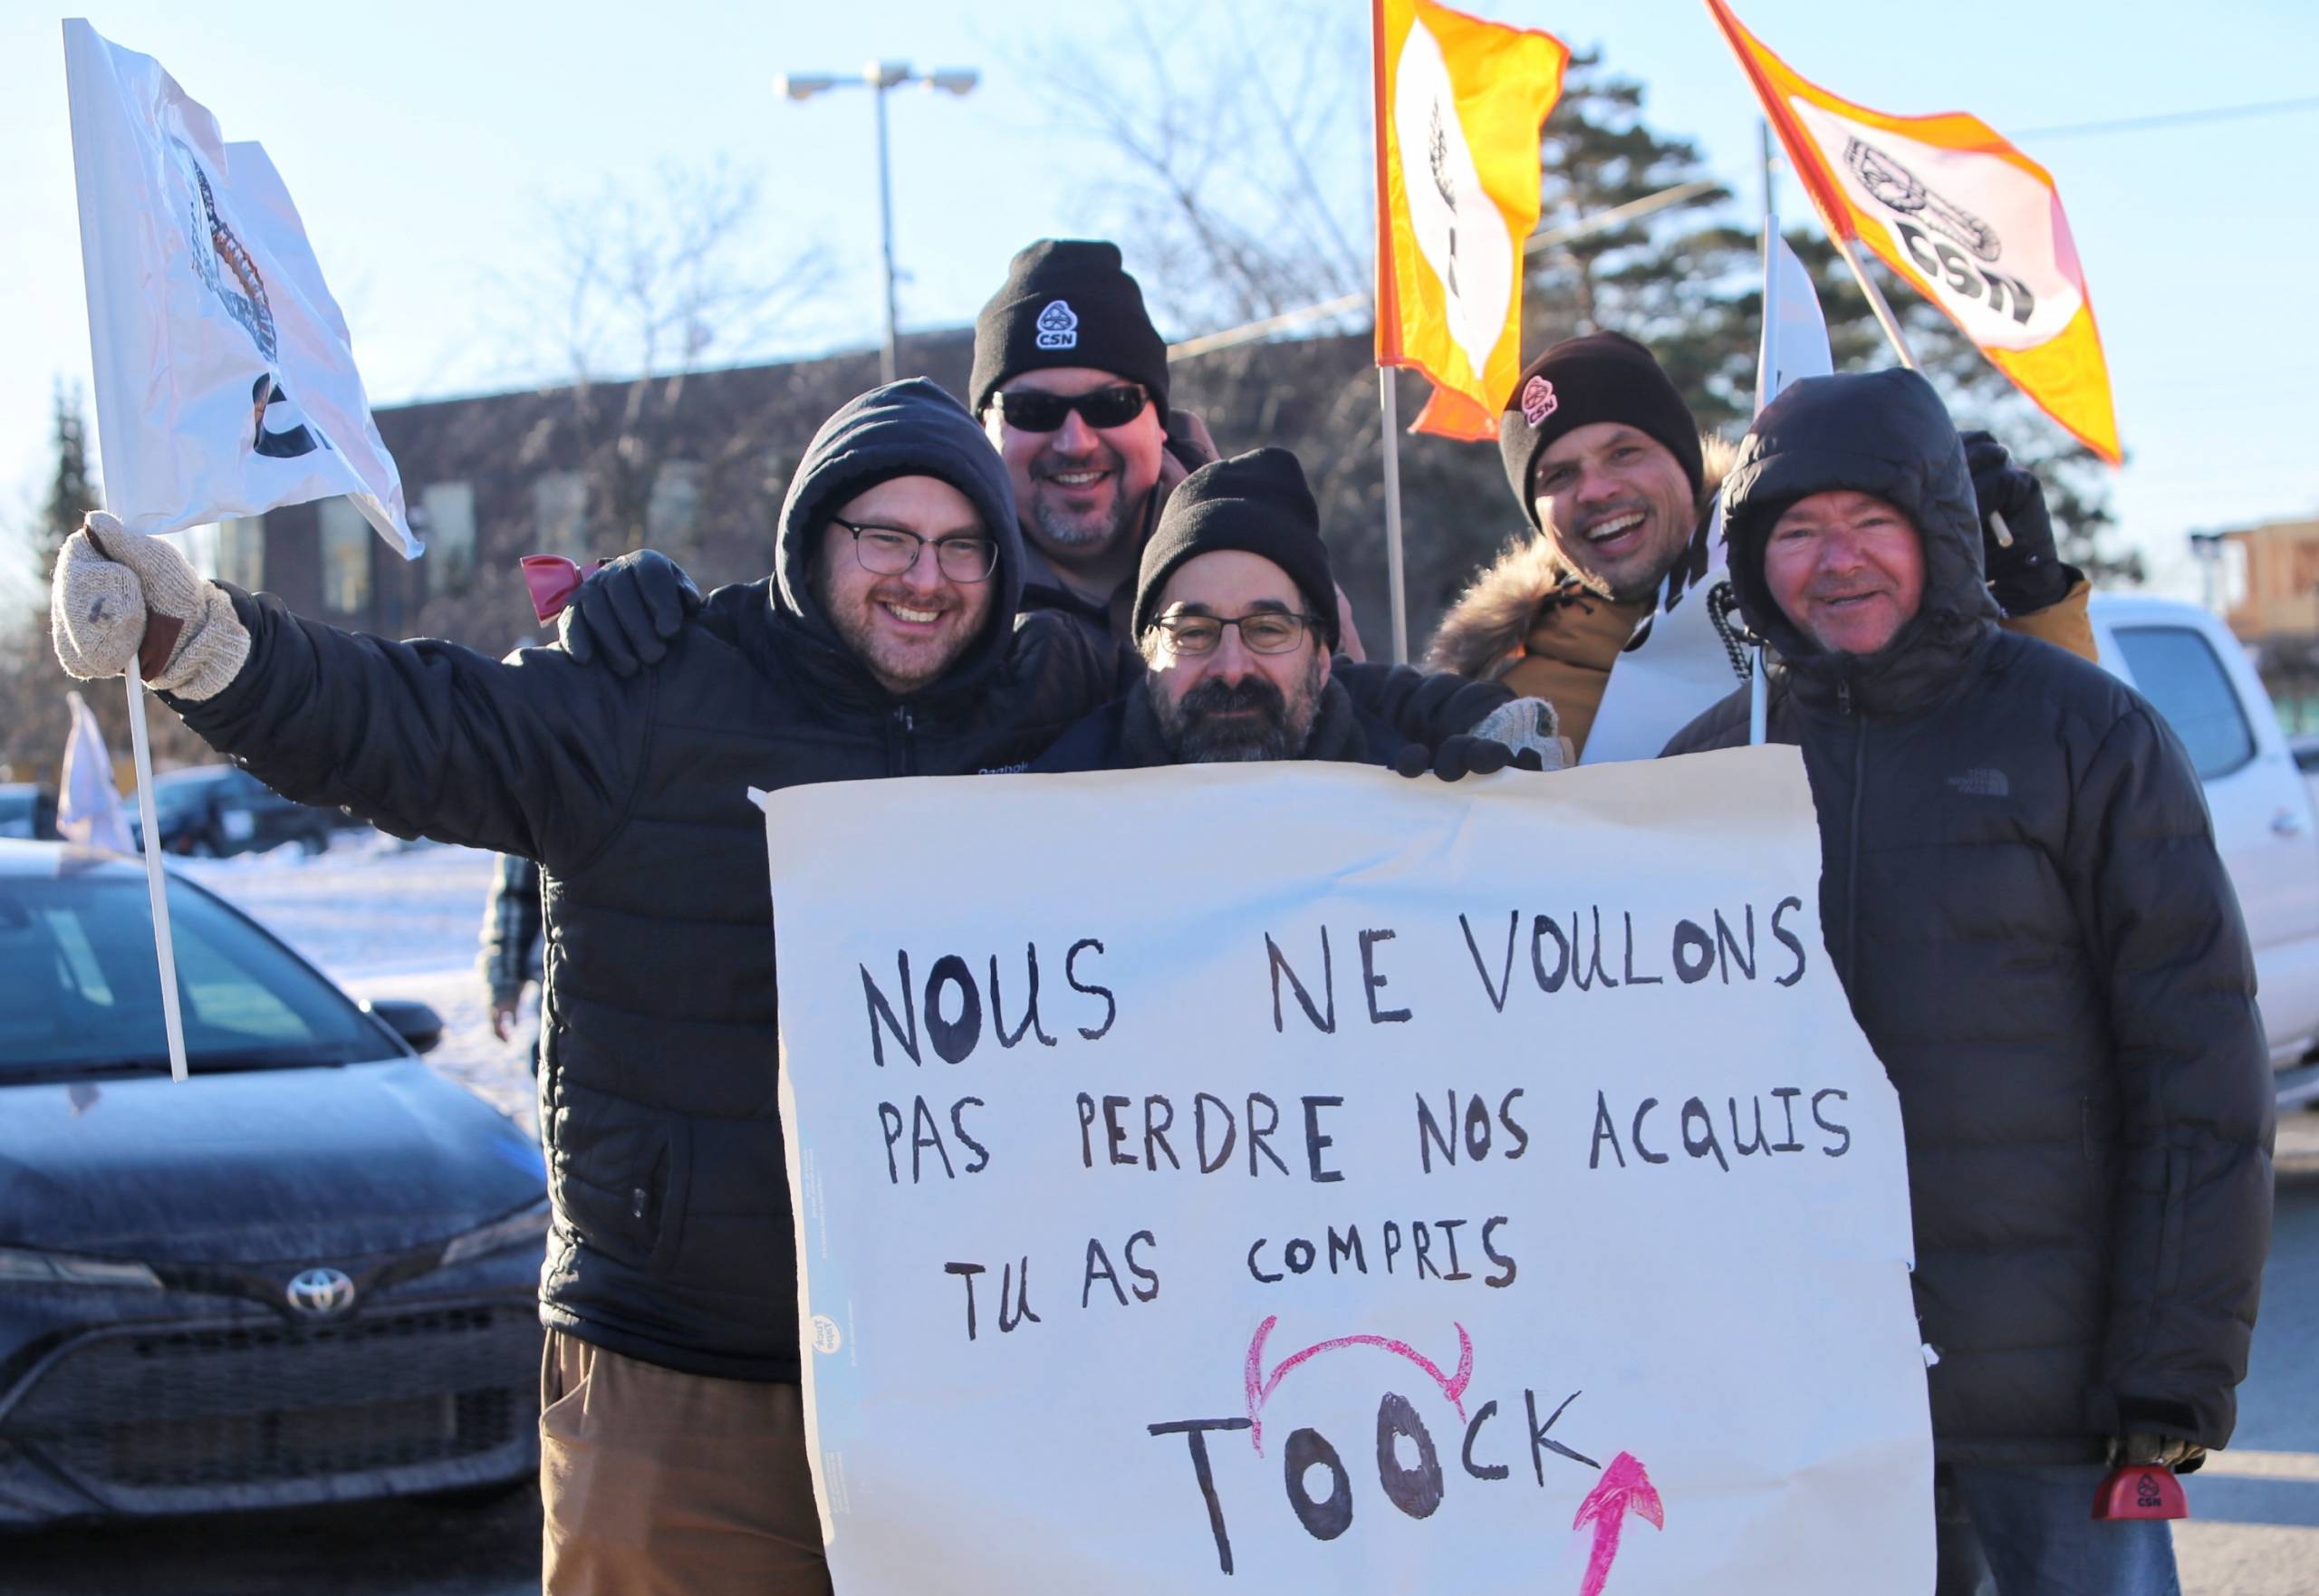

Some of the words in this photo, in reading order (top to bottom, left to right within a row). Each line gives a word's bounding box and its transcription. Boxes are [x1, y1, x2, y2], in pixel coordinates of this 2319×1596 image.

[1895, 220, 2035, 326] CSN
[1039, 332, 1073, 346] CSN
[1529, 399, 1554, 424] CSN
[859, 938, 1116, 1067] NOUS
[1265, 924, 1412, 1034] NE
[1458, 896, 1805, 1013] VOULONS
[878, 1095, 991, 1184] PAS
[1076, 1092, 1345, 1183] PERDRE
[1416, 1088, 1528, 1174] NOS
[944, 1255, 1041, 1341] TU
[1082, 1230, 1160, 1309] AS
[1247, 1216, 1516, 1289] COMPRIS
[1147, 1389, 1602, 1576] TOOCK
[2137, 1497, 2161, 1507] CSN
